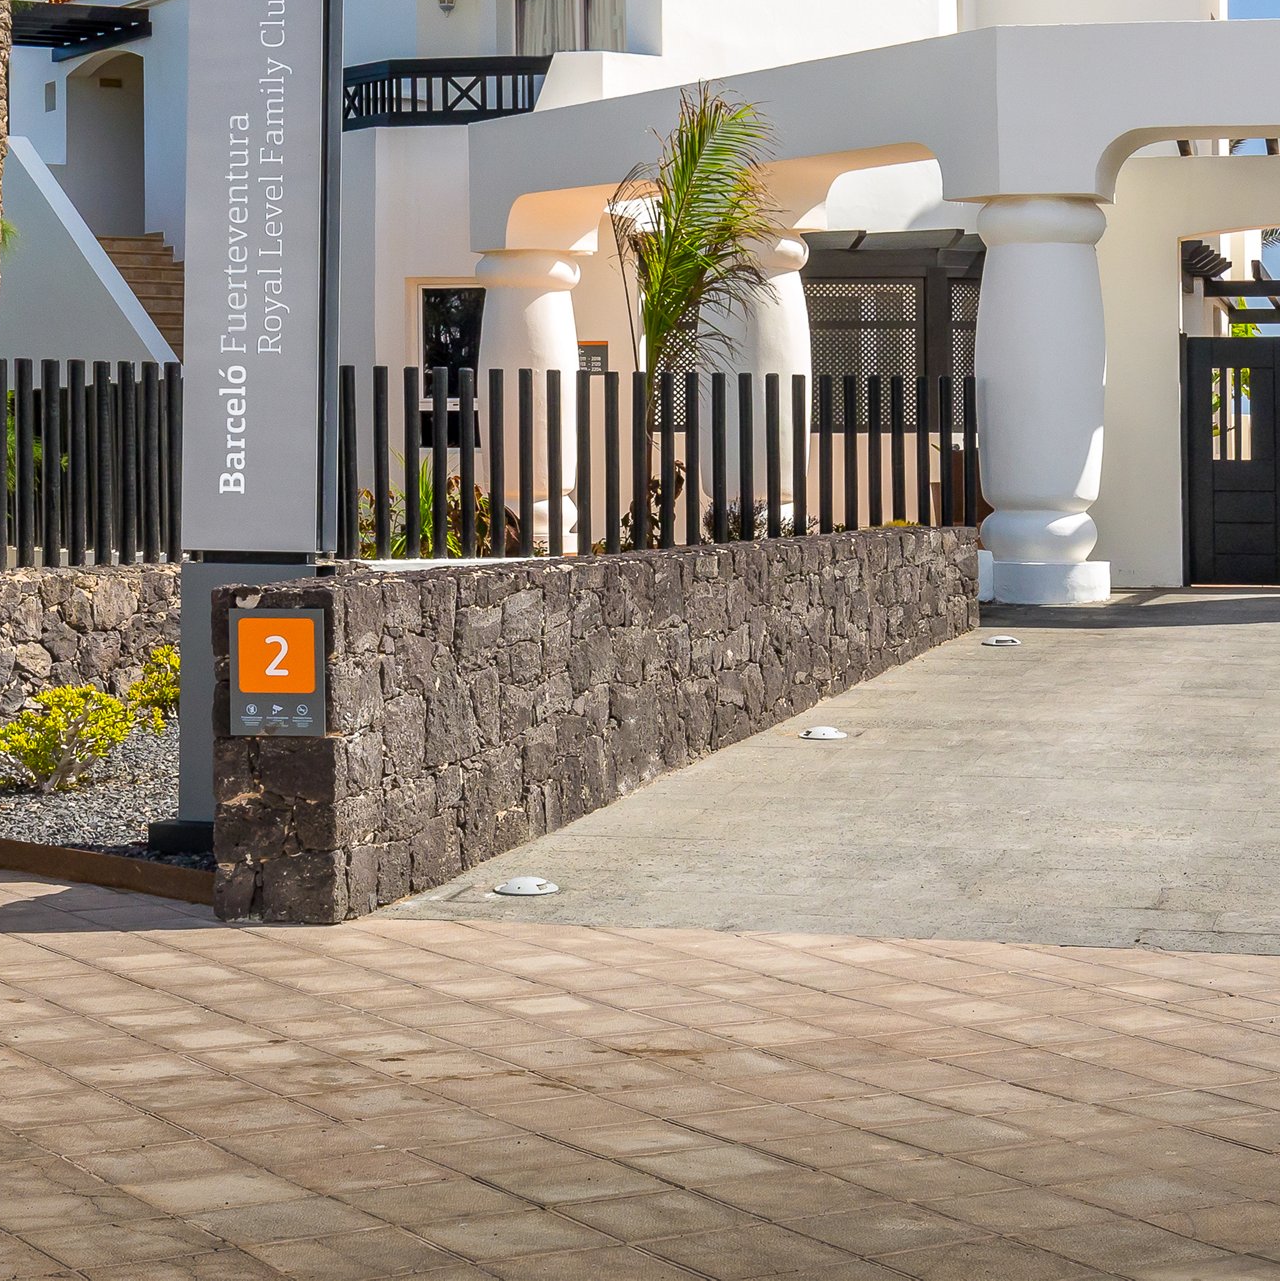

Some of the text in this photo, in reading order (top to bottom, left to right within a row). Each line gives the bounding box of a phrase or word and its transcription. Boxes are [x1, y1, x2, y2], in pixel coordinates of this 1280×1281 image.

[258, 56, 293, 165] Family
[258, 174, 284, 257] Level
[218, 112, 250, 495] Barceló Fuerteventura
[257, 267, 290, 354] Royal
[264, 635, 289, 676] 2
